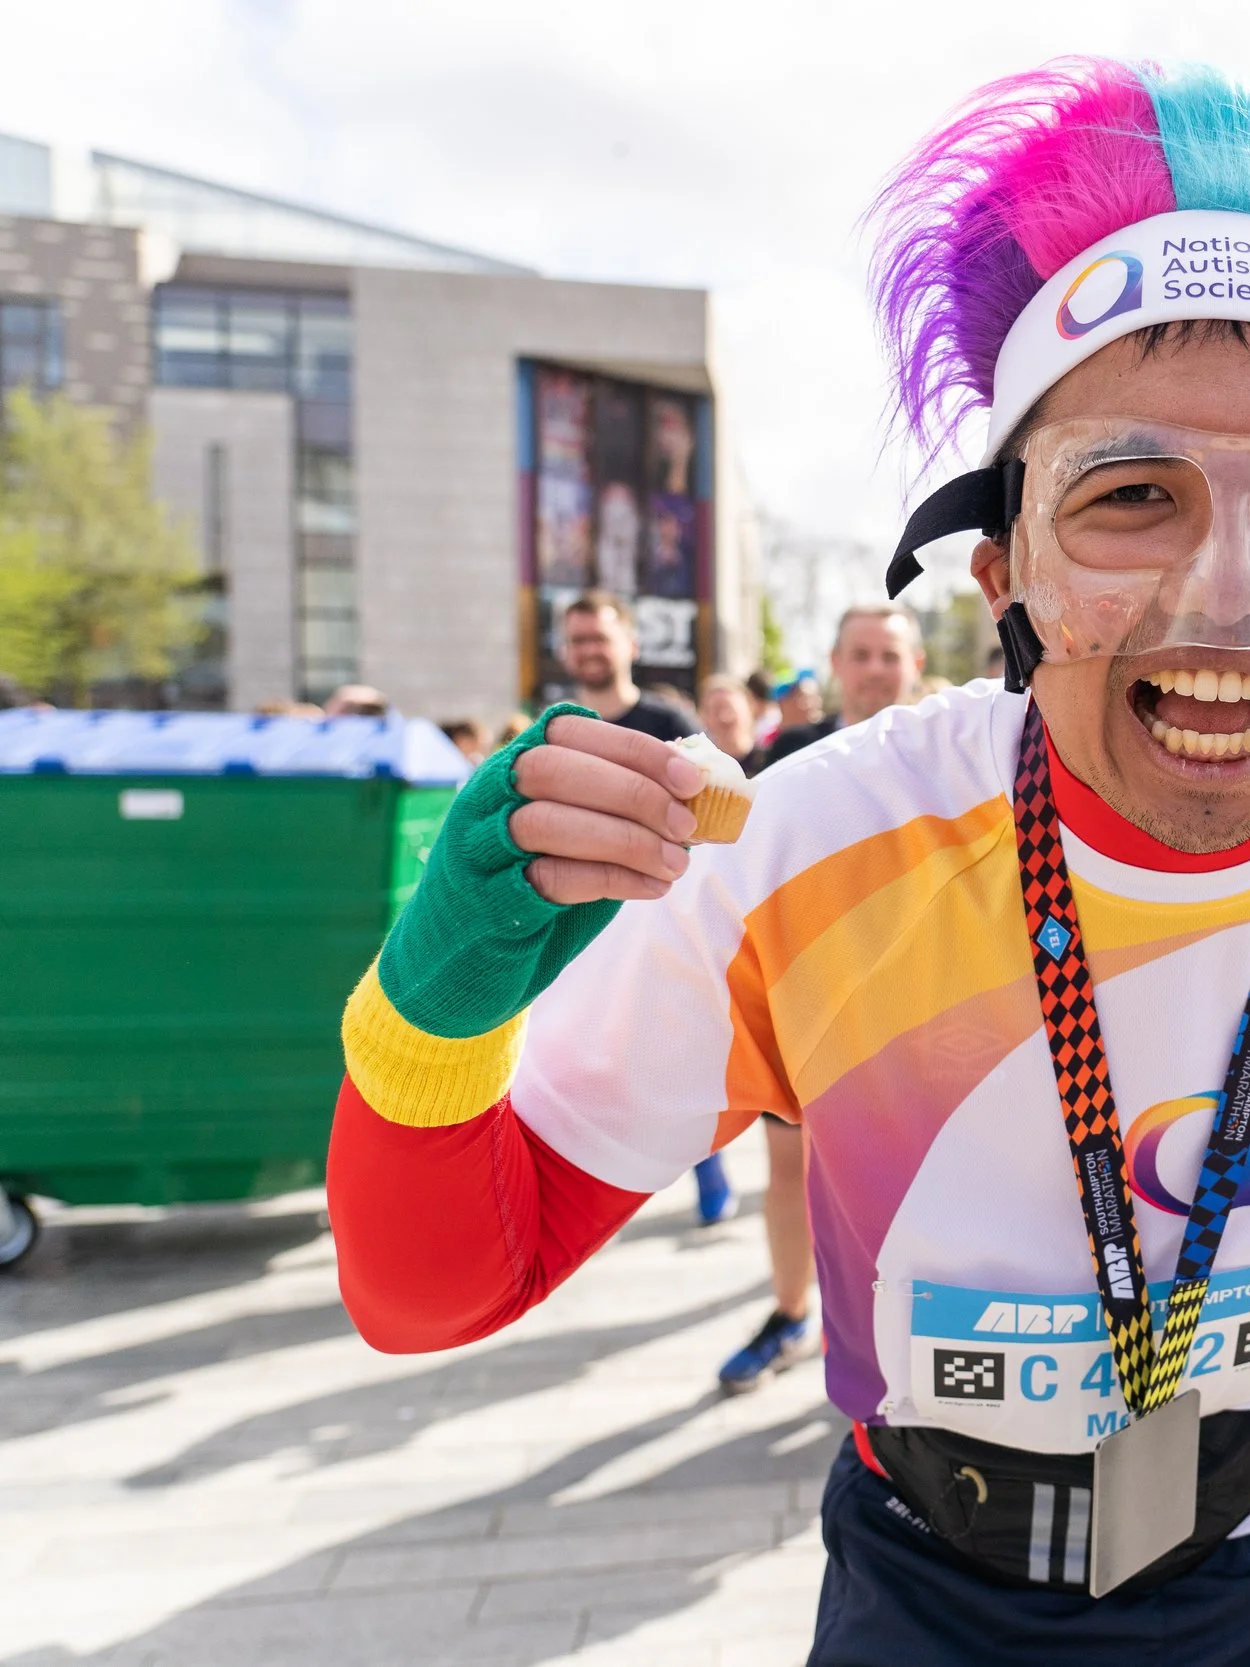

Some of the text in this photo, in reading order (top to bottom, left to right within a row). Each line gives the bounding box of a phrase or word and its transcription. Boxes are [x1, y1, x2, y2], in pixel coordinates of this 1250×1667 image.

[1085, 1152, 1109, 1235] SOUTHAMPTON
[1096, 1148, 1122, 1233] MARATHON
[1104, 1243, 1135, 1299] ABP
[973, 1301, 1088, 1334] ABP
[1019, 1331, 1225, 1402] C 42
